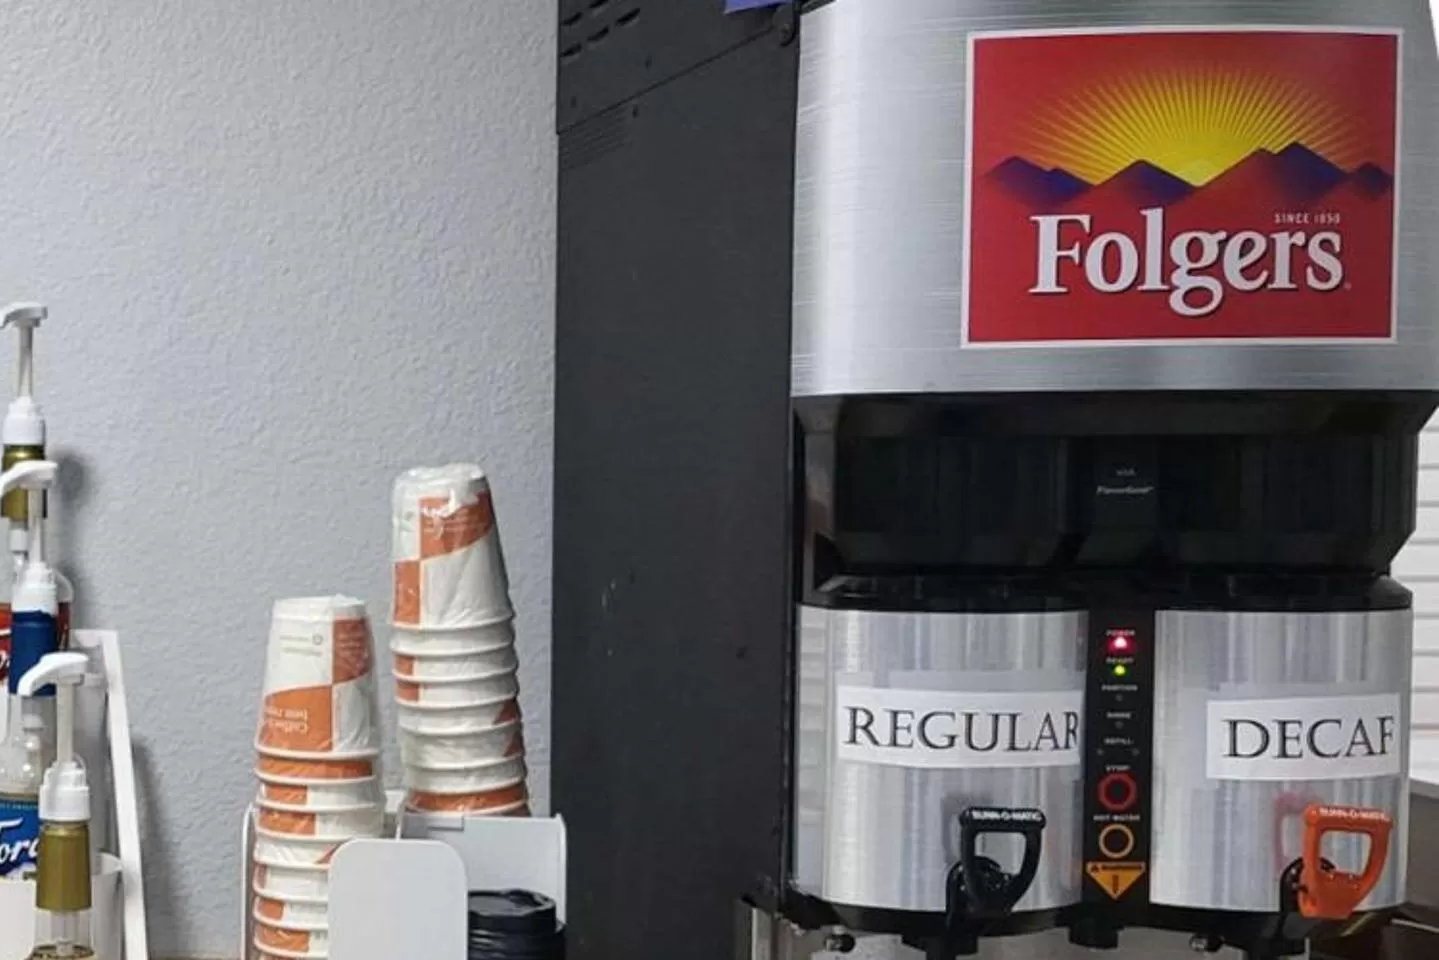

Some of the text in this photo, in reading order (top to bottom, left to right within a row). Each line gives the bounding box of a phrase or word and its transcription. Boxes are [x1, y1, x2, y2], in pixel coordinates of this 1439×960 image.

[1027, 206, 1344, 317] Folgers
[843, 705, 1079, 752] REGULAR
[1221, 715, 1395, 759] DECAF
